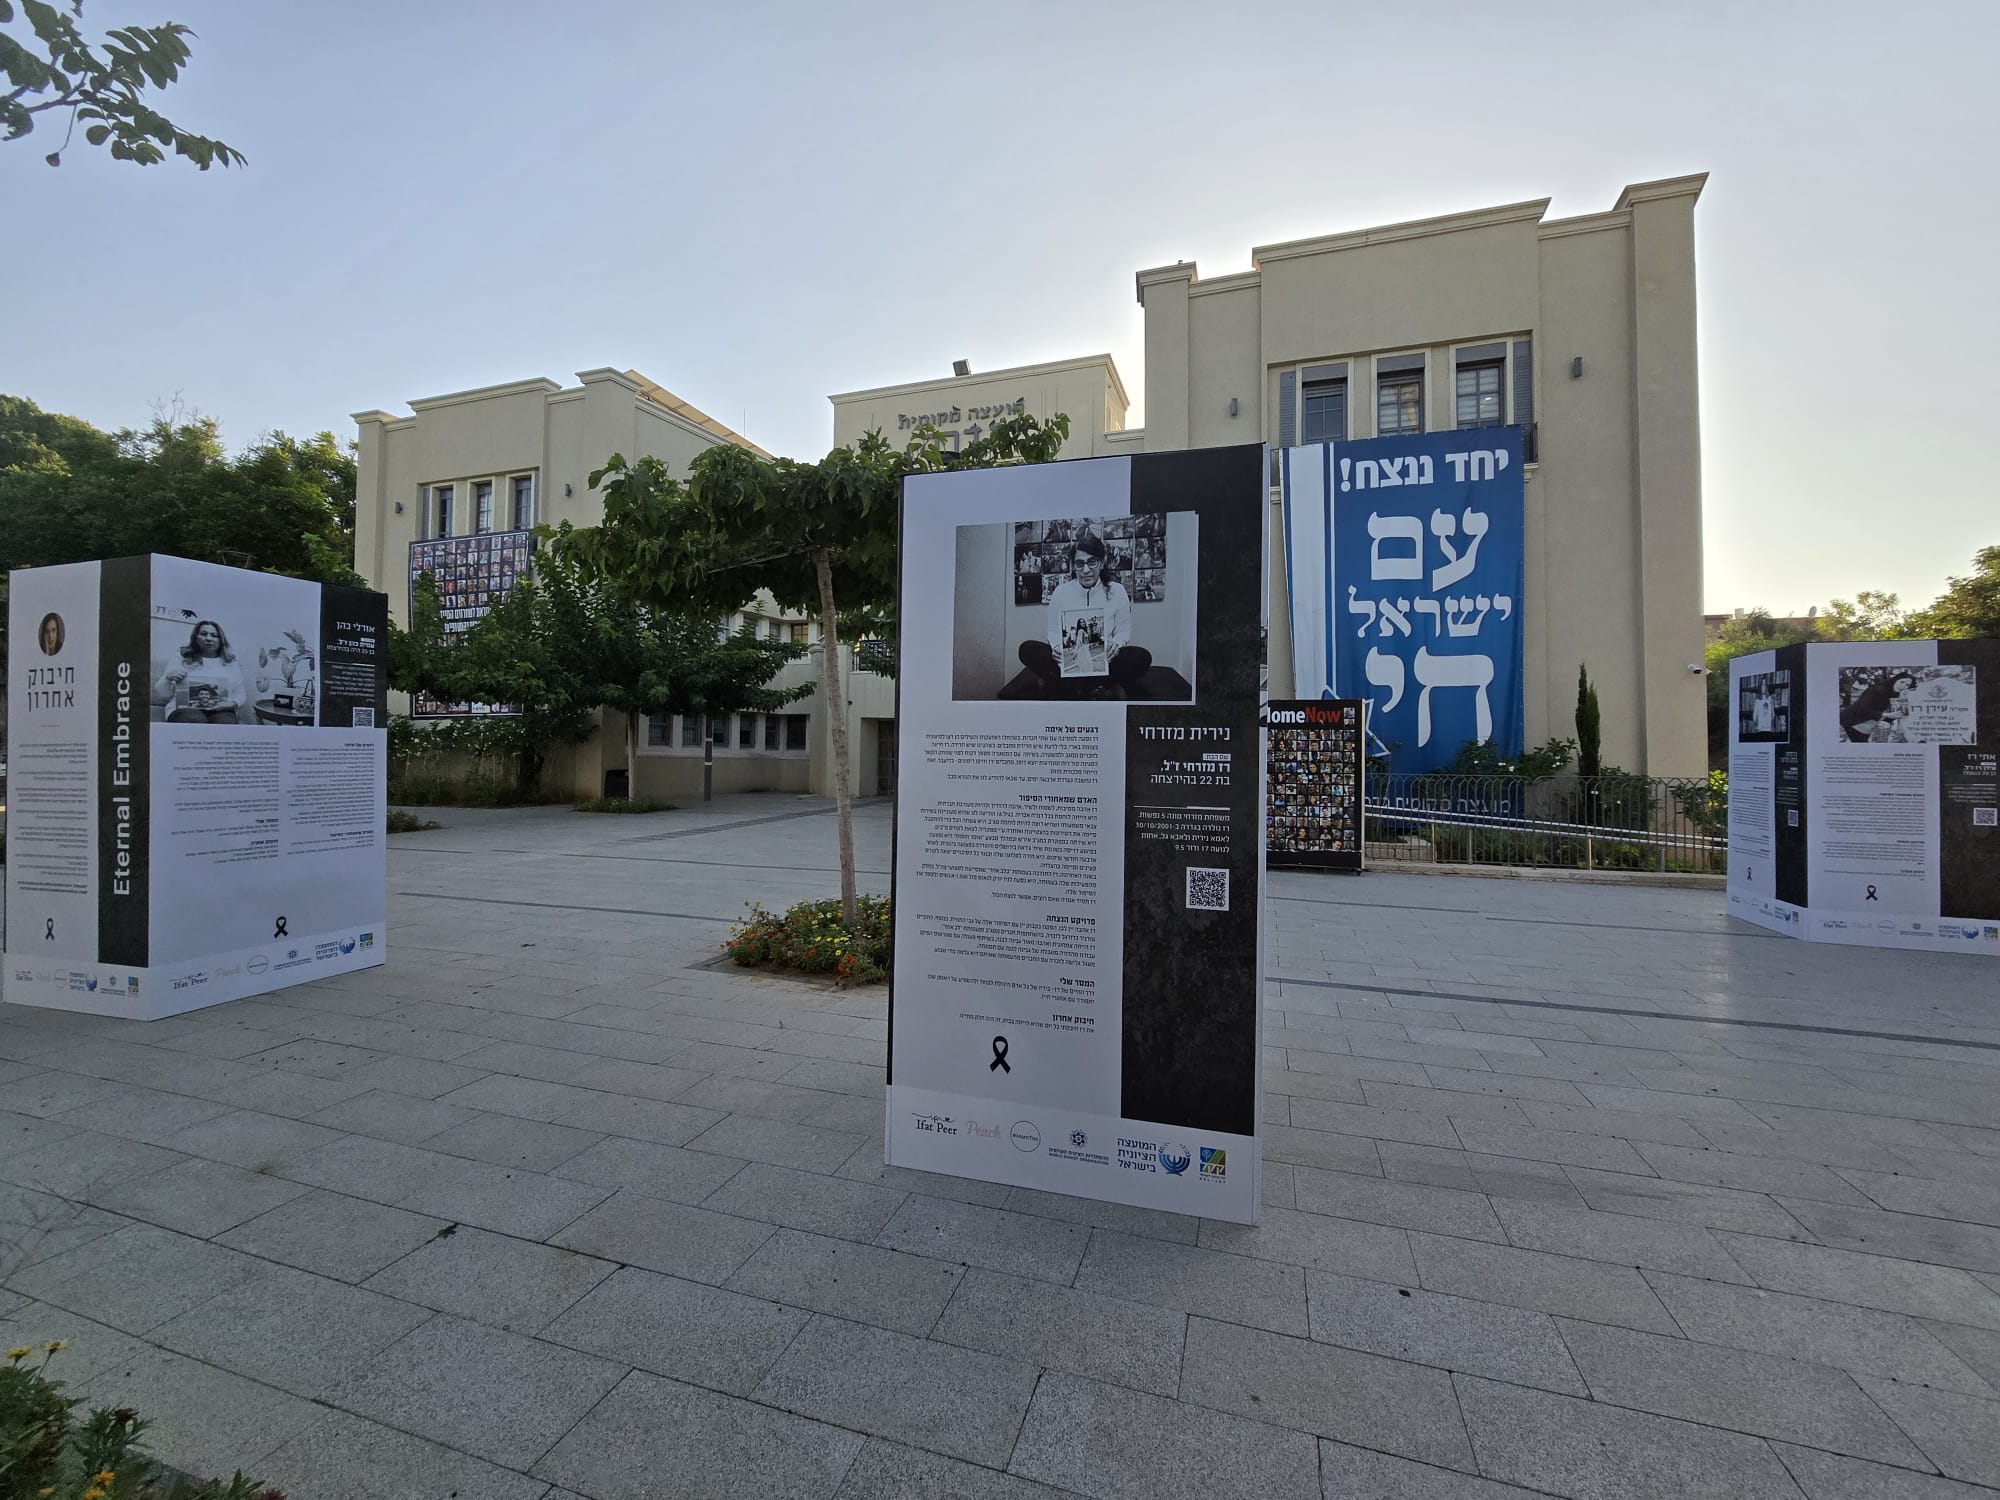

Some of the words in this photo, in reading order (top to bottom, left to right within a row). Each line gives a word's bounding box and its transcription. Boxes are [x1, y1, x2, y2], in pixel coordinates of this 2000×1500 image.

[898, 409, 961, 430] מקומית
[1445, 449, 1509, 482] יחד
[1340, 455, 1434, 493] ננצח!
[1367, 506, 1489, 592] עם
[1348, 585, 1512, 638] ישראל
[336, 621, 351, 630] כהן
[353, 622, 376, 633] אורלי
[28, 666, 74, 689] חיבוק
[27, 690, 74, 712] אחרון
[1365, 645, 1495, 748] חי
[113, 662, 131, 786] Embrace
[1045, 725, 1063, 733] אימה
[1064, 725, 1075, 733] של
[1076, 725, 1099, 734] רגעים
[1139, 726, 1185, 740] מזרחי
[1189, 727, 1230, 741] נירית
[1182, 761, 1215, 772] מזרחי
[1218, 762, 1230, 772] רז
[1151, 774, 1197, 784] בהירצחה
[1199, 776, 1213, 785] 22
[1215, 776, 1230, 785] בת
[1018, 794, 1042, 803] הסיפור
[1043, 795, 1075, 804] שמאחורי
[1076, 796, 1098, 804] האדם
[113, 797, 130, 896] Eternal
[1045, 914, 1069, 924] הנצחה
[1070, 916, 1096, 926] פרויקט
[1059, 977, 1073, 986] שלי
[1074, 978, 1095, 989] המסר
[1052, 1014, 1072, 1023] אחרון
[1073, 1015, 1095, 1025] חיבוק
[916, 1119, 934, 1131] Ifat
[937, 1122, 957, 1135] Peer
[1117, 1138, 1157, 1151] המועצה
[1117, 1149, 1157, 1162] הציונית
[1117, 1159, 1157, 1173] בישראל
